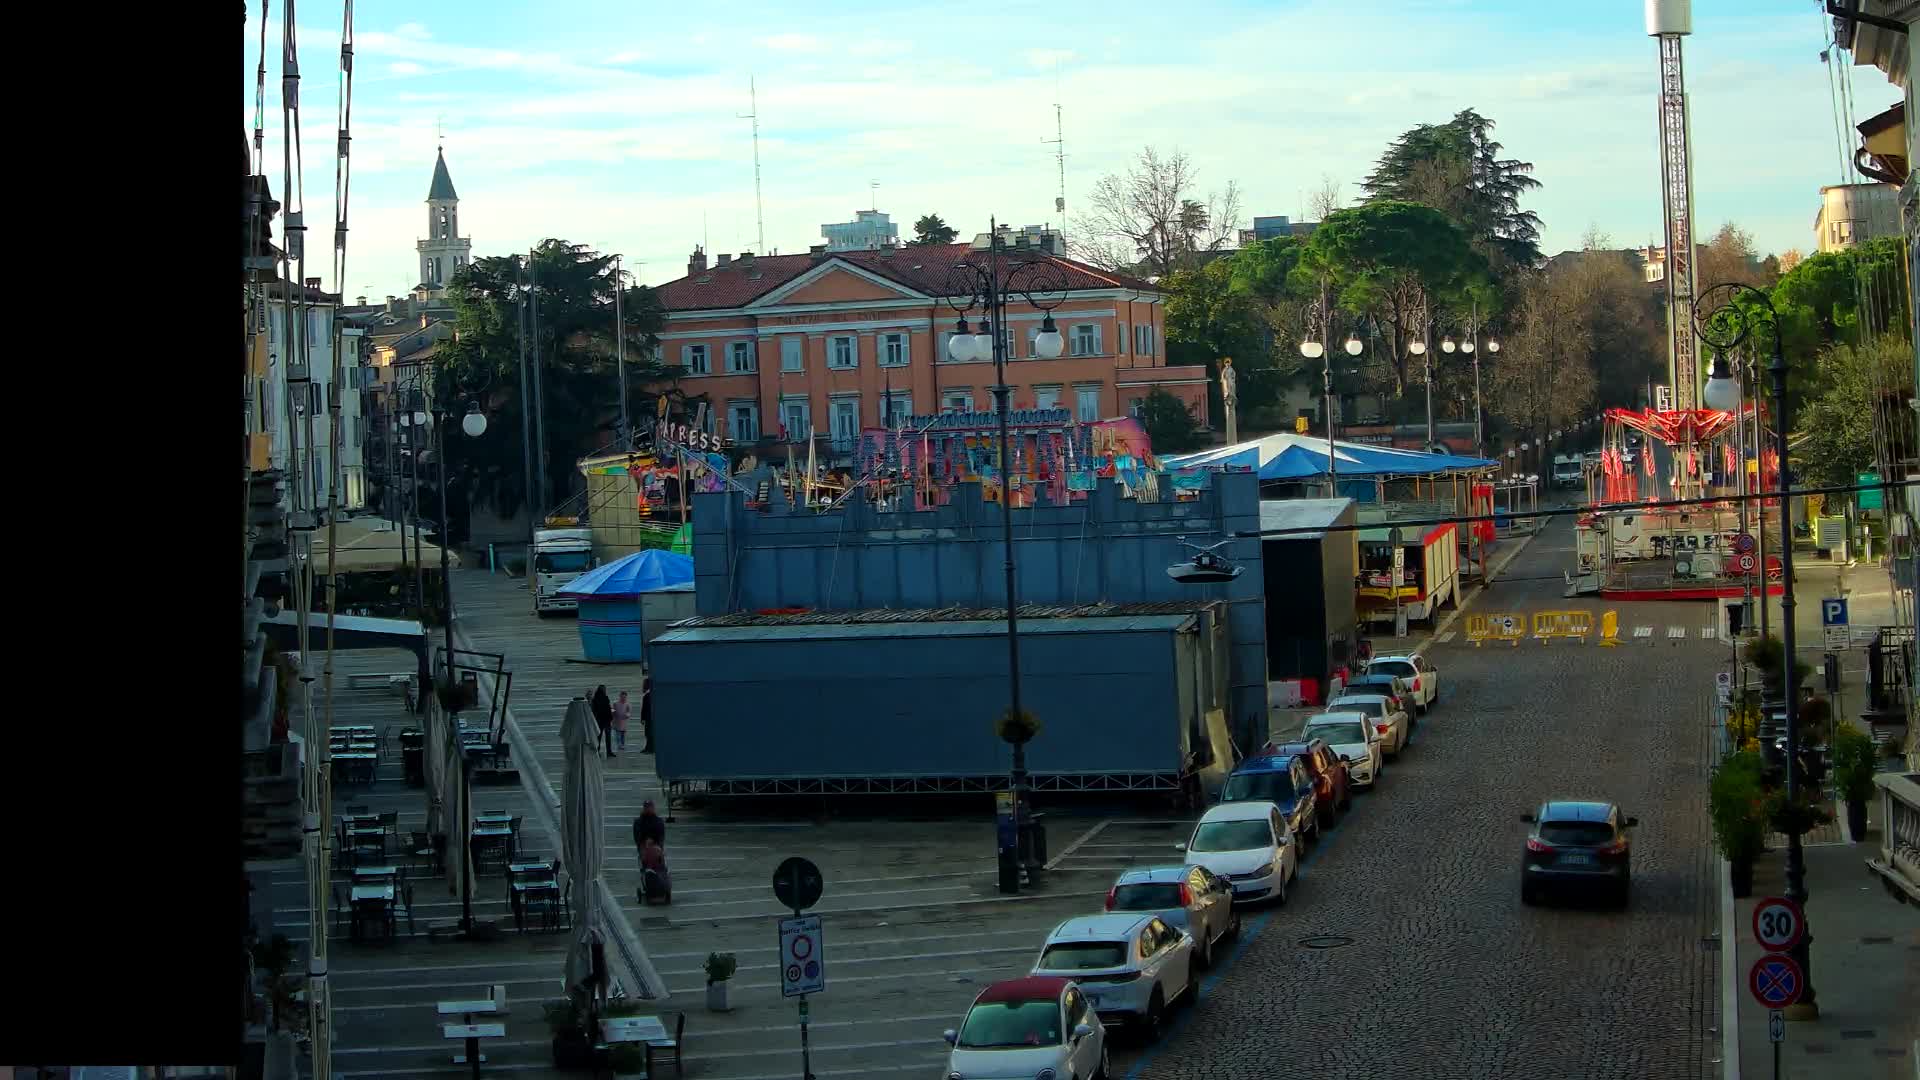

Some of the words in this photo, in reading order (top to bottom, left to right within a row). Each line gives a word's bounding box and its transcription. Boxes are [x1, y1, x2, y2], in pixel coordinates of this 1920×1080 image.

[1741, 558, 1752, 567] 20
[1828, 602, 1842, 622] P
[1762, 912, 1791, 938] 30
